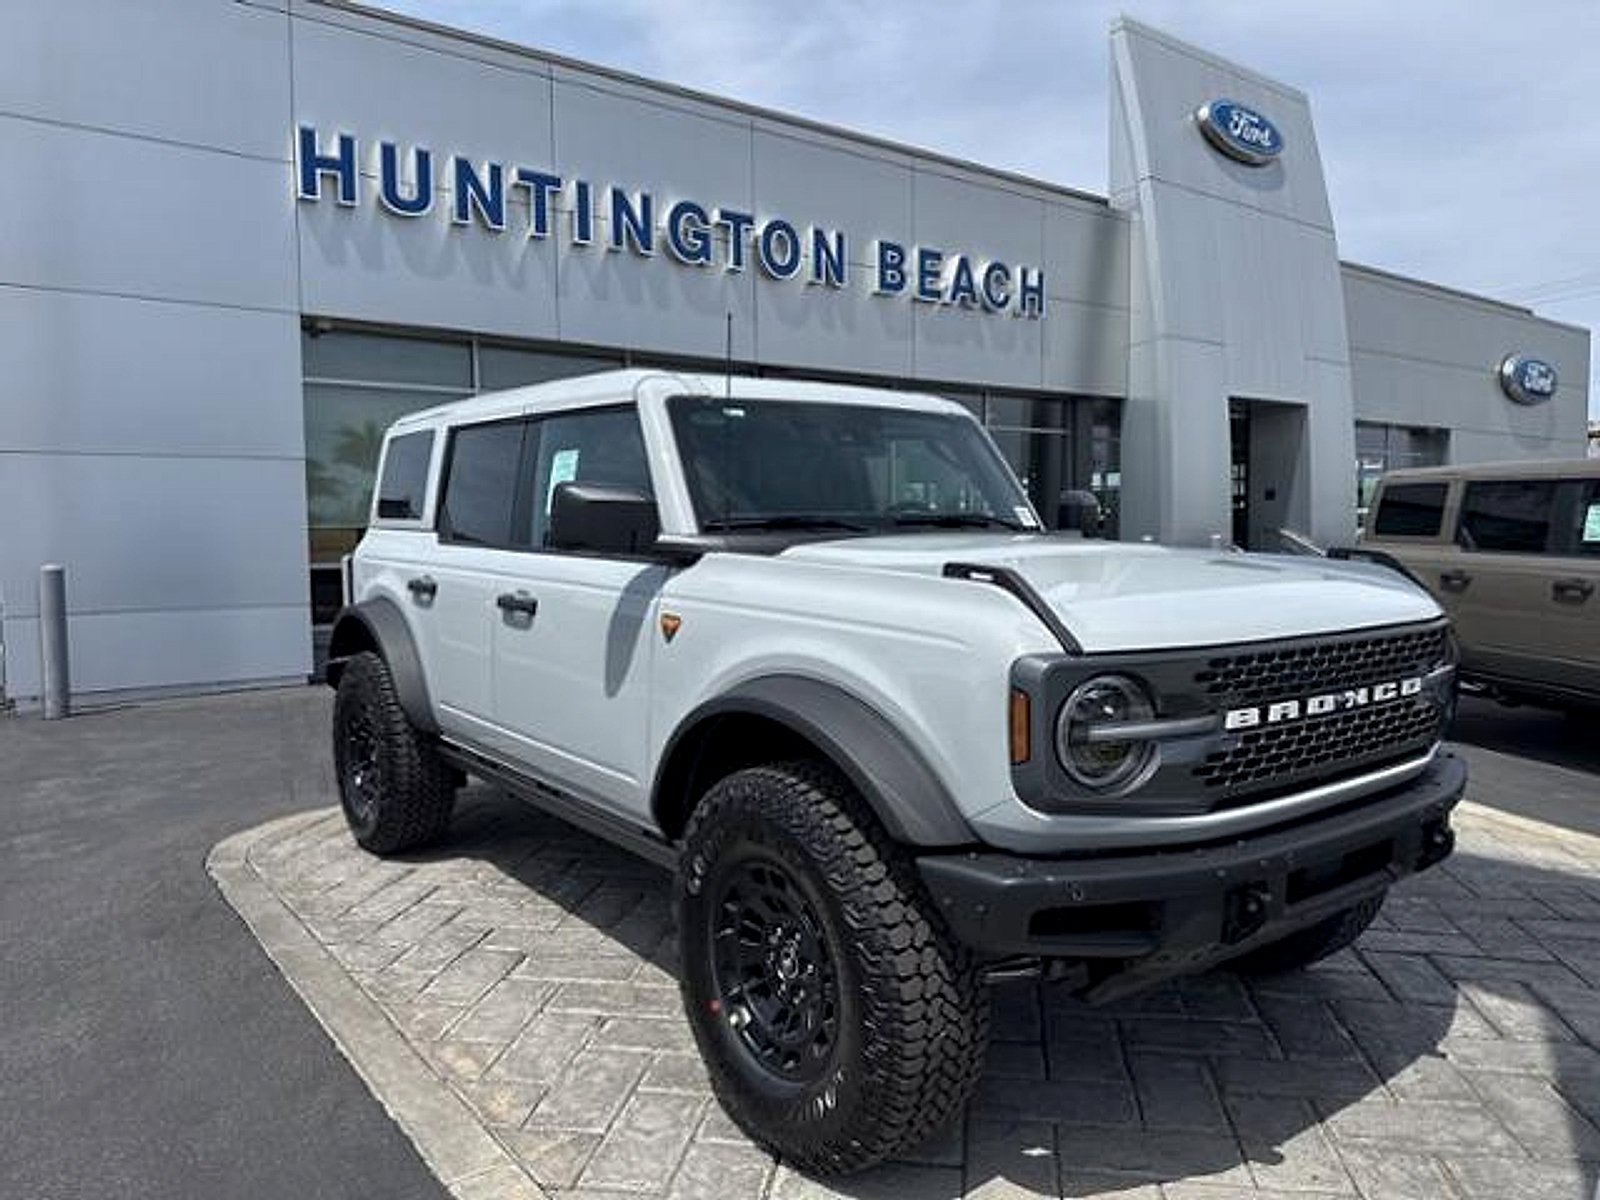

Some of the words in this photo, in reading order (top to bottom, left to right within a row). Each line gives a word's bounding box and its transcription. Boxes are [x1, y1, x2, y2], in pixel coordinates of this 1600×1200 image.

[1229, 109, 1272, 146] Ford
[297, 125, 846, 288] HUNTINGTON
[876, 238, 1045, 318] BEACH
[1225, 677, 1421, 729] BRONCO
